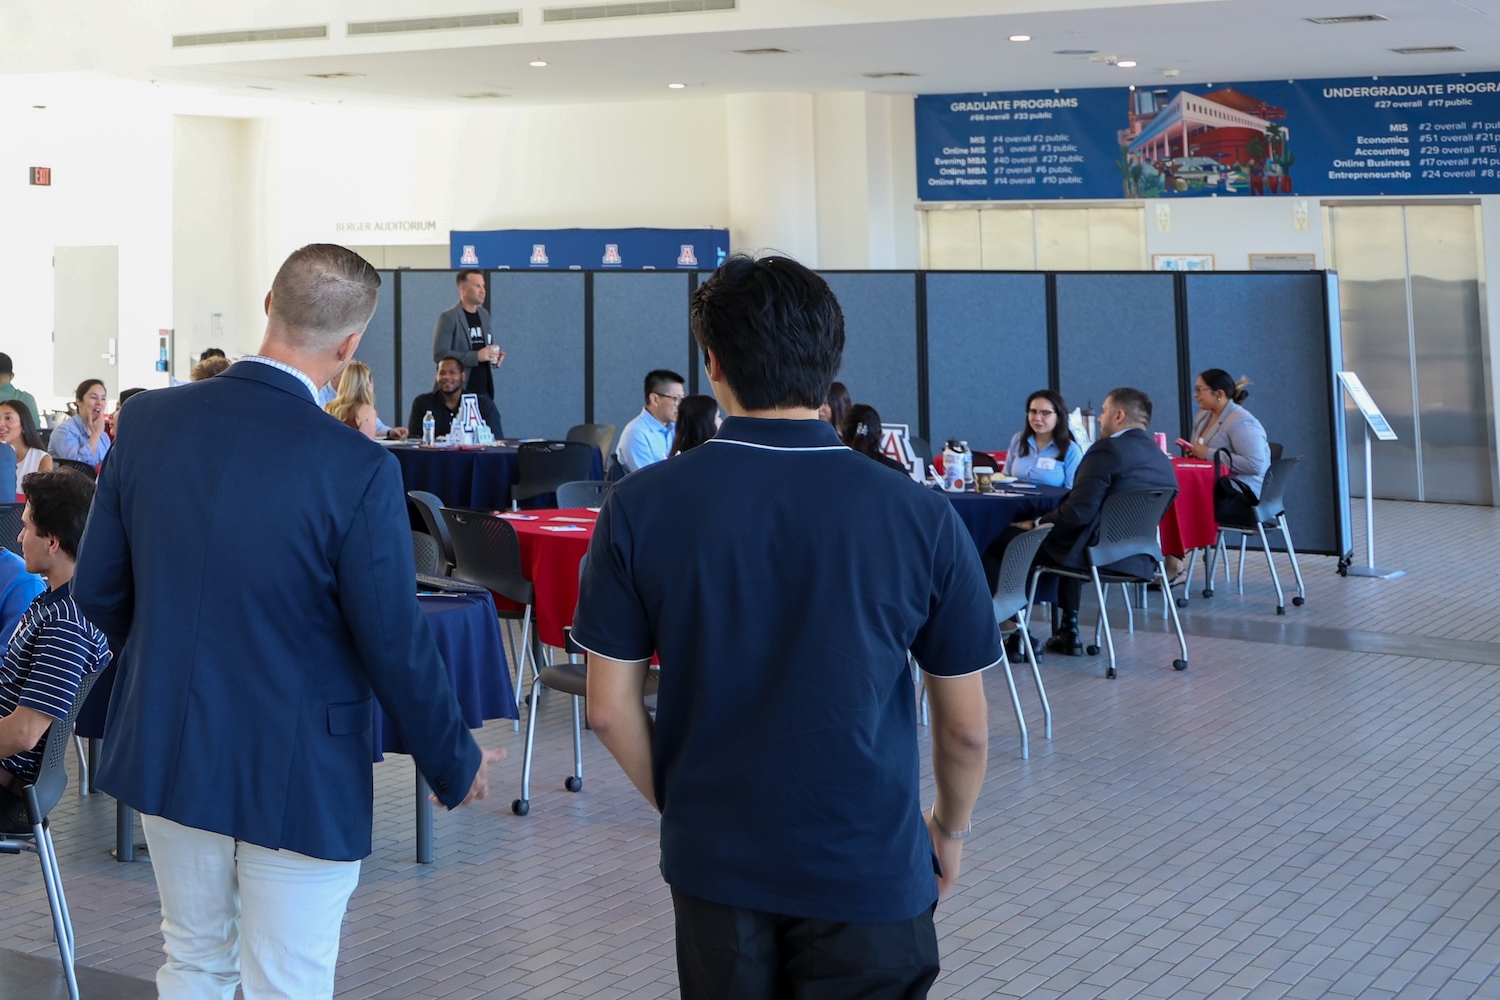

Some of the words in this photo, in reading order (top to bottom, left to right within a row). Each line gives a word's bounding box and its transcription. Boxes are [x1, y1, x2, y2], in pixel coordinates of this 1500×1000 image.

[1323, 84, 1443, 98] UNDERGRADUATE
[951, 101, 1011, 112] GRADUATE
[1013, 98, 1078, 110] PROGRAMS
[1445, 99, 1472, 107] public
[1355, 148, 1409, 156] Accounting
[935, 158, 966, 166] Evening
[35, 168, 49, 184] EXIT
[1329, 171, 1411, 180] Entrepreneurship
[336, 222, 371, 232] BERGER
[374, 221, 436, 231] AUDITORIUM
[460, 245, 479, 264] A
[530, 244, 549, 264] A
[602, 244, 622, 264] A
[677, 244, 698, 265] A
